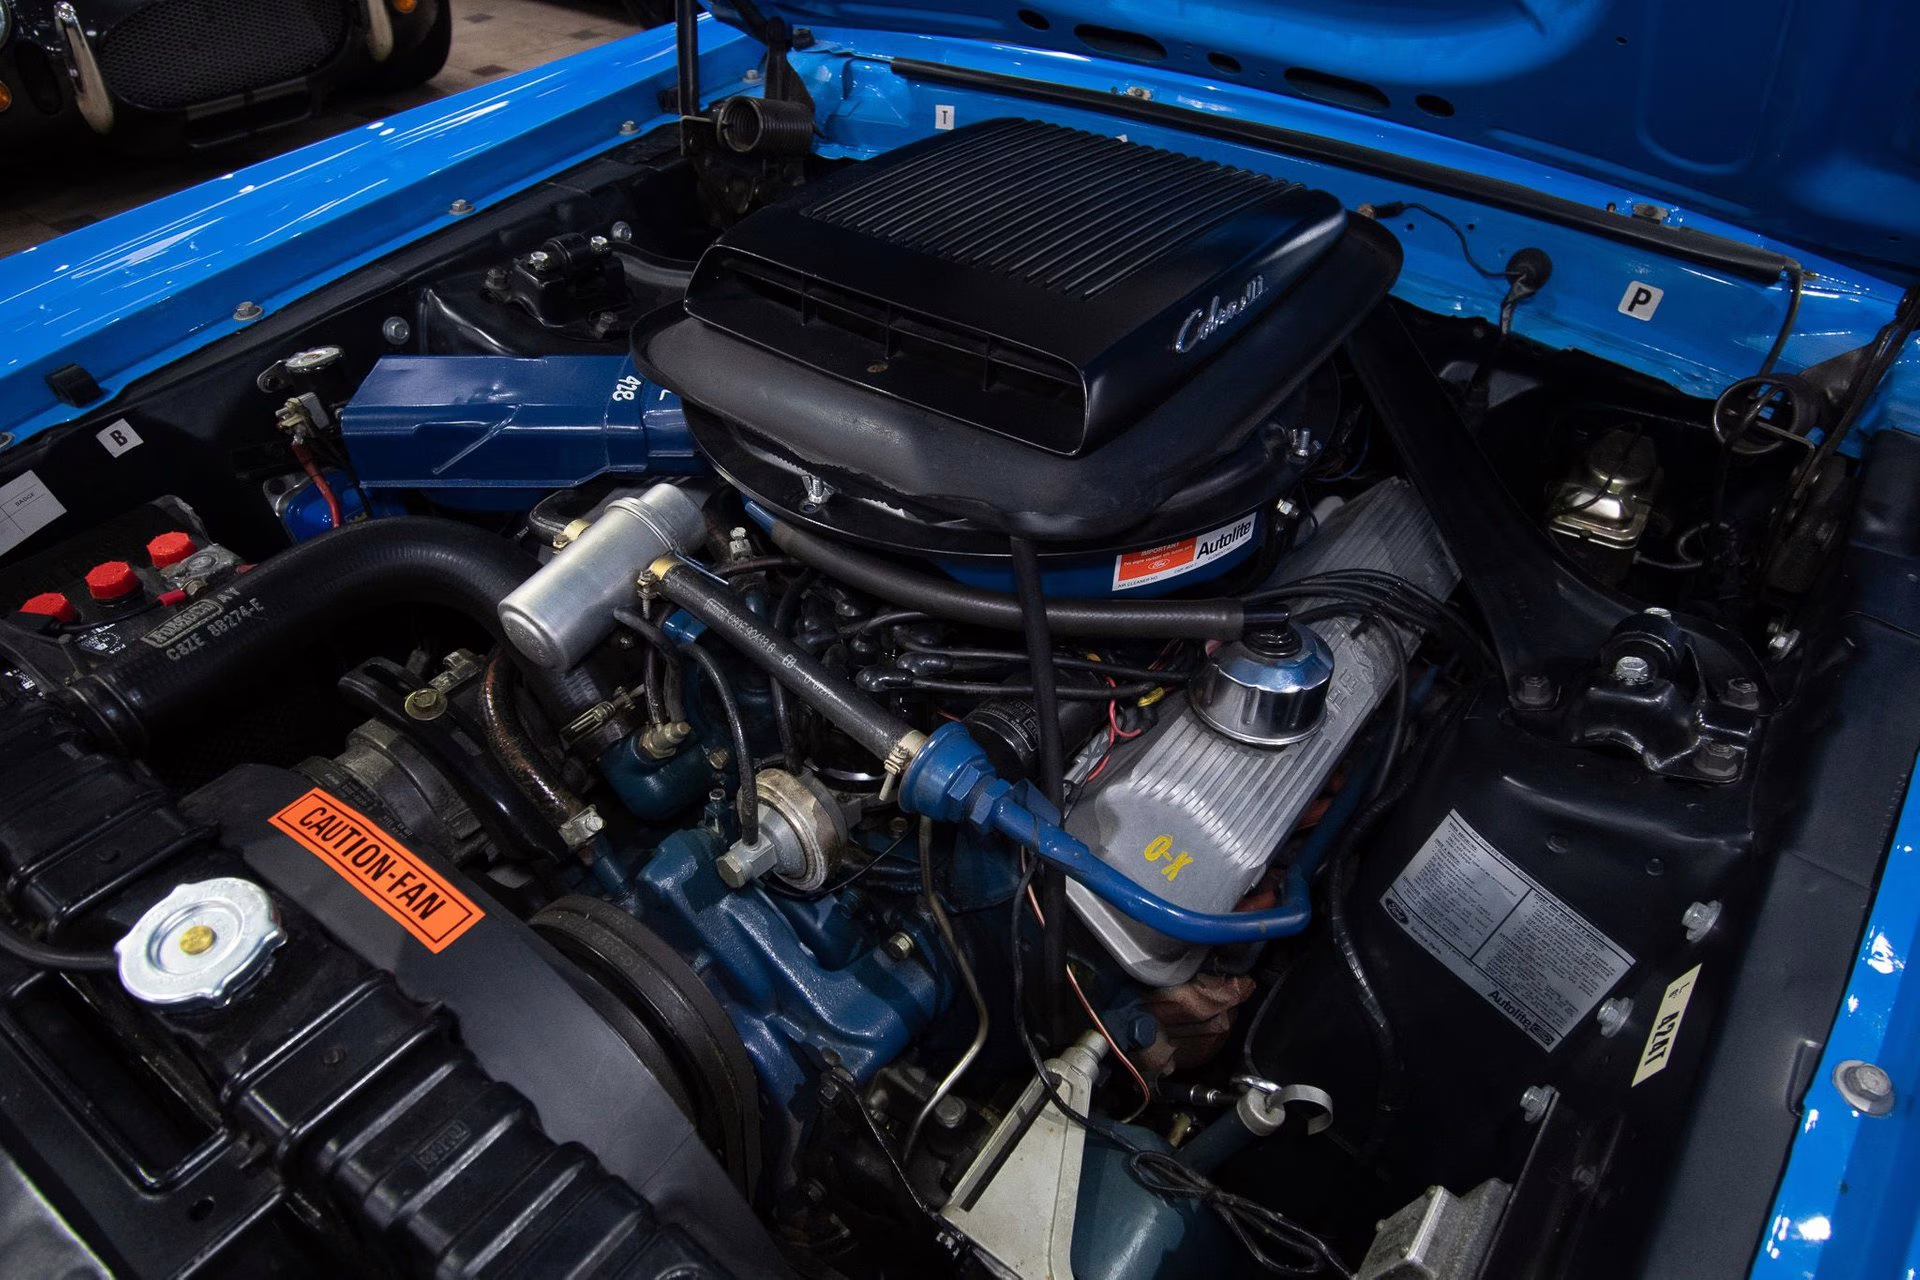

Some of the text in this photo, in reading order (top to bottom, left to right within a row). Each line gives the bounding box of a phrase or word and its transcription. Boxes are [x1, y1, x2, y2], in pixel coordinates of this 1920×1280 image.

[941, 110, 949, 125] T
[1627, 287, 1652, 312] P
[109, 429, 129, 447] B
[15, 492, 35, 507] BADGE
[1141, 542, 1180, 556] IMPORTANT
[1196, 521, 1253, 560] Autolite
[299, 806, 447, 921] CAUTION-FAN
[1487, 990, 1532, 1028] Autolite
